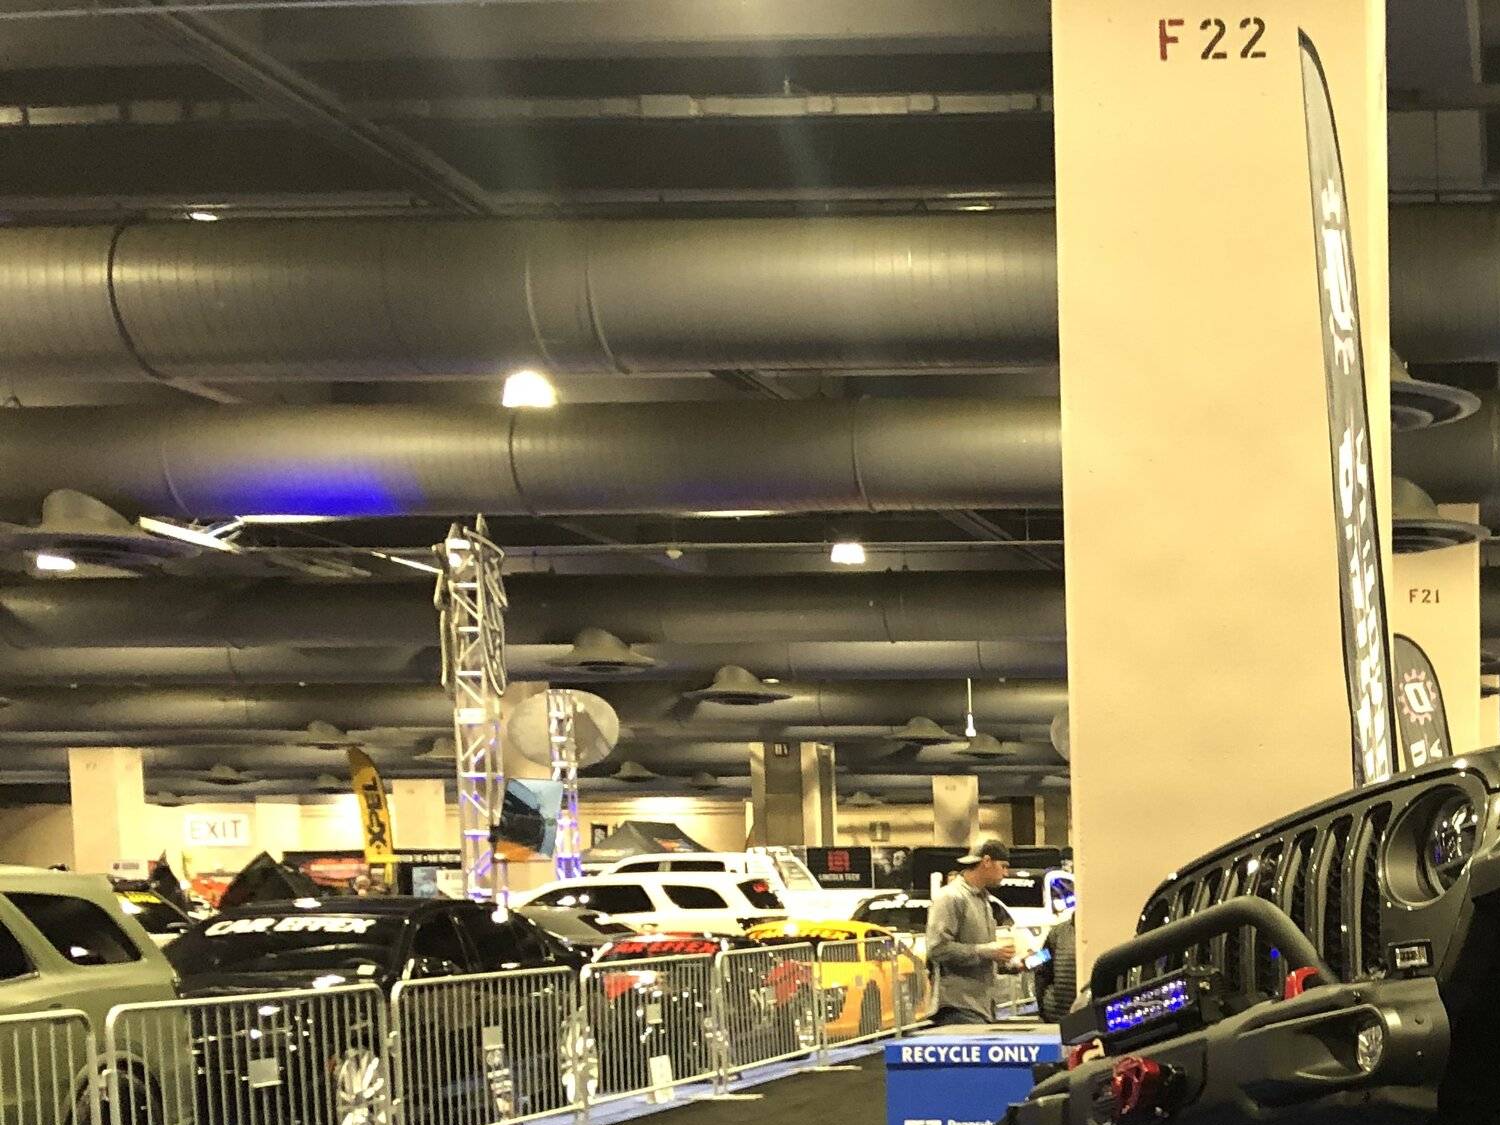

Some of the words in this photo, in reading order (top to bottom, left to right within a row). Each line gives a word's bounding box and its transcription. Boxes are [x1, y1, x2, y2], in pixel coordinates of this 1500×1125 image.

[1158, 17, 1266, 61] F22
[1408, 588, 1441, 604] F21
[190, 819, 242, 840] EXIT
[204, 917, 275, 937] CAR
[901, 1046, 981, 1063] RECYCLE
[988, 1047, 1039, 1062] ONLY
